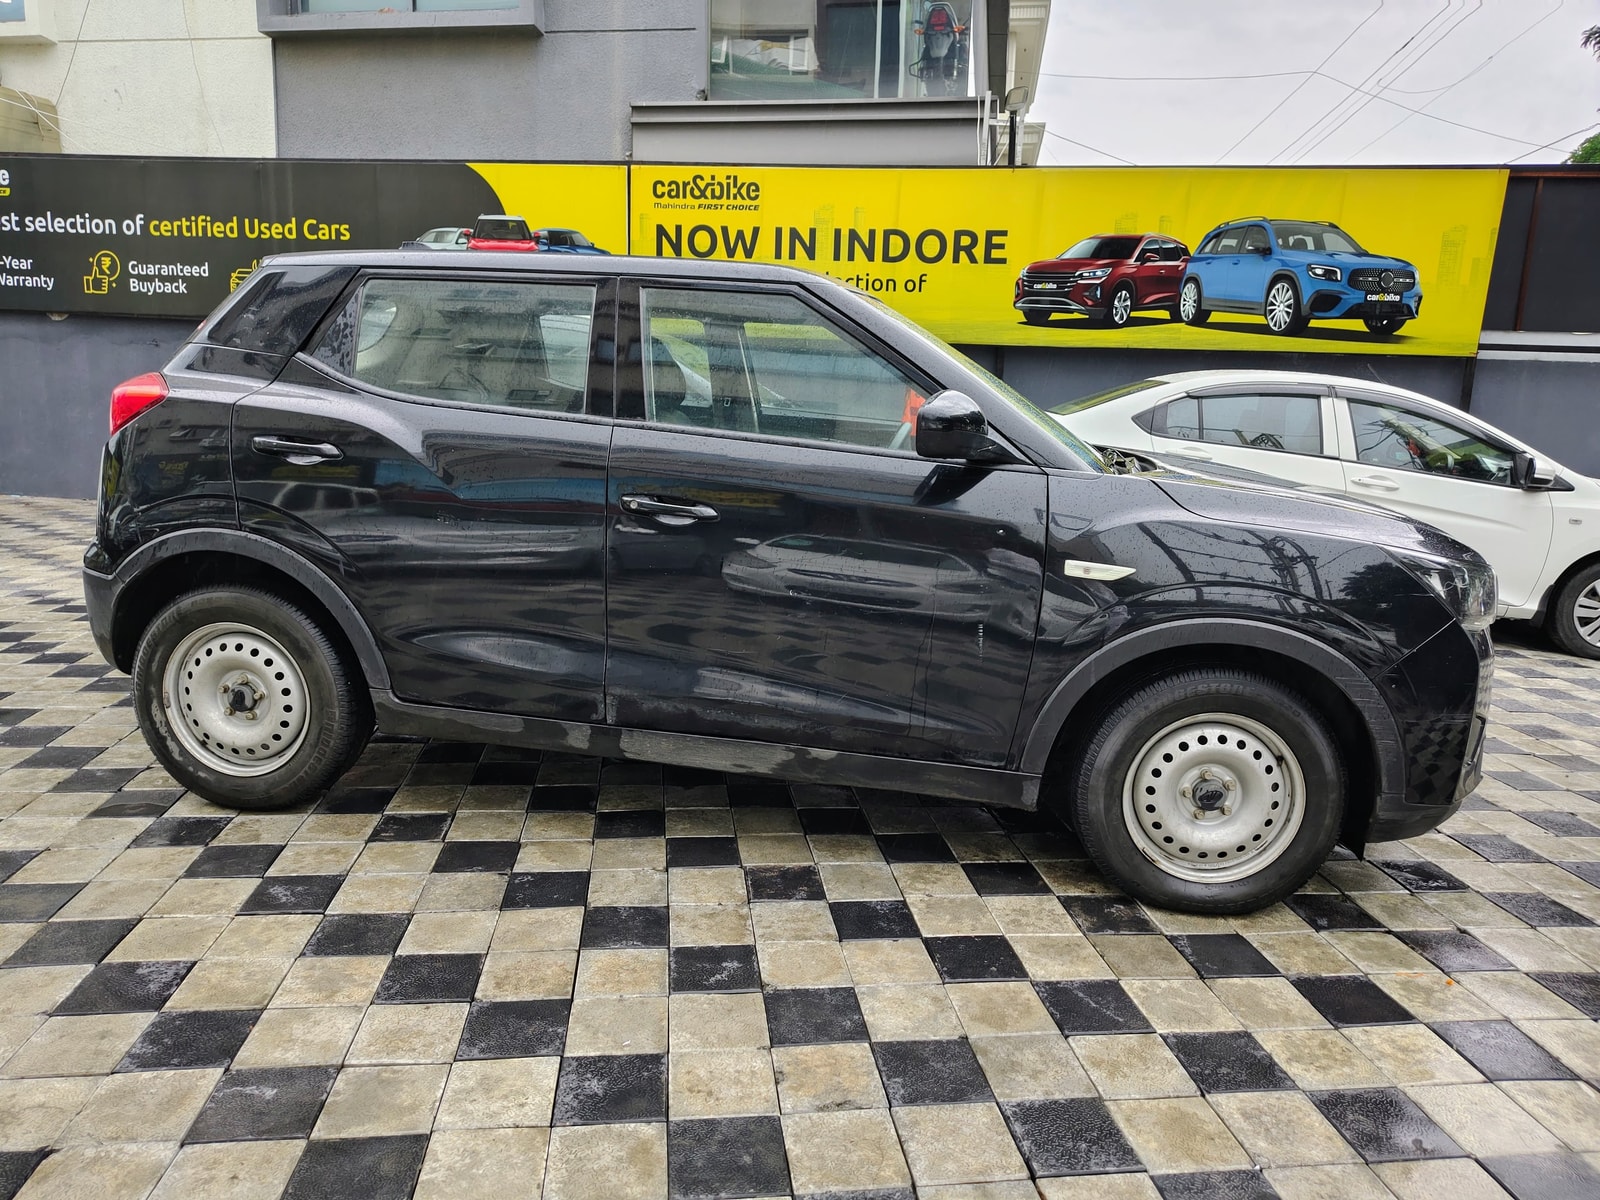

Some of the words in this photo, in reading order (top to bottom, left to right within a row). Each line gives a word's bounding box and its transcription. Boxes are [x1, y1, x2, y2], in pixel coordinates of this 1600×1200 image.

[652, 174, 760, 201] car&bike
[653, 202, 695, 210] Mahindra
[0, 211, 20, 231] st
[25, 211, 117, 235] selection
[122, 213, 144, 235] of
[149, 215, 238, 238] certified
[244, 217, 297, 240] Used
[303, 219, 351, 241] Cars
[656, 224, 760, 259] NOW
[774, 226, 817, 261] IN
[833, 228, 1009, 264] INDORE
[128, 260, 209, 277] Guaranteed
[129, 278, 188, 296] Buyback
[904, 273, 928, 293] of
[1366, 293, 1401, 302] car&bike
